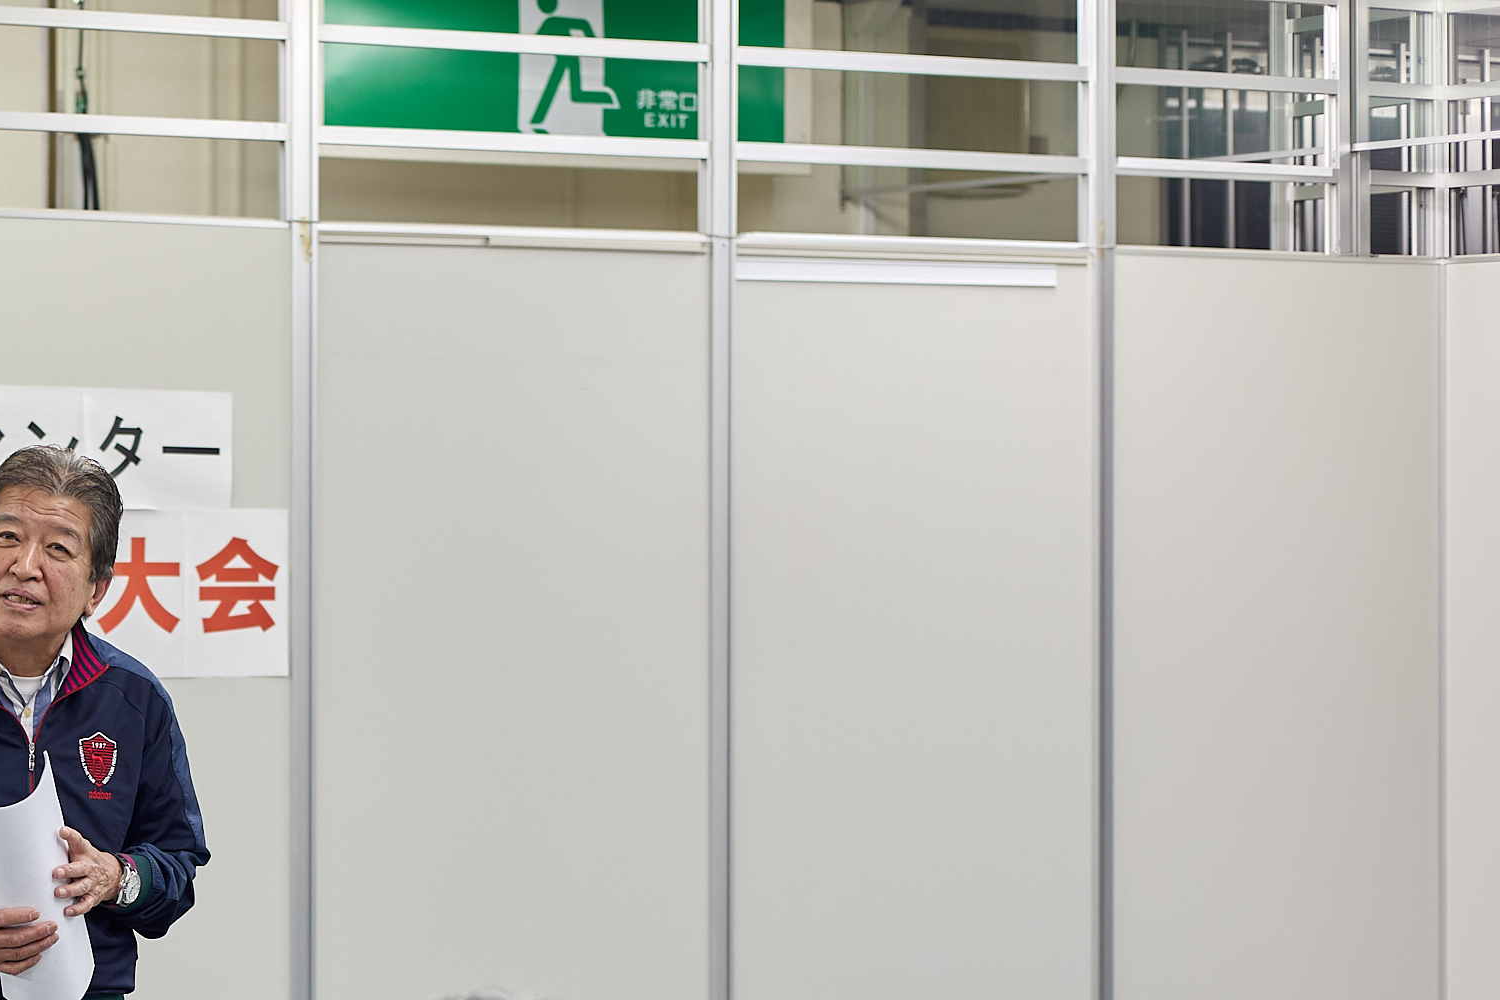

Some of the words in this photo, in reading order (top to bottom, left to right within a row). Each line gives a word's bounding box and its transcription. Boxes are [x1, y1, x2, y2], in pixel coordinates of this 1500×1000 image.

[636, 88, 698, 112] 非常口
[644, 112, 689, 128] EXIT
